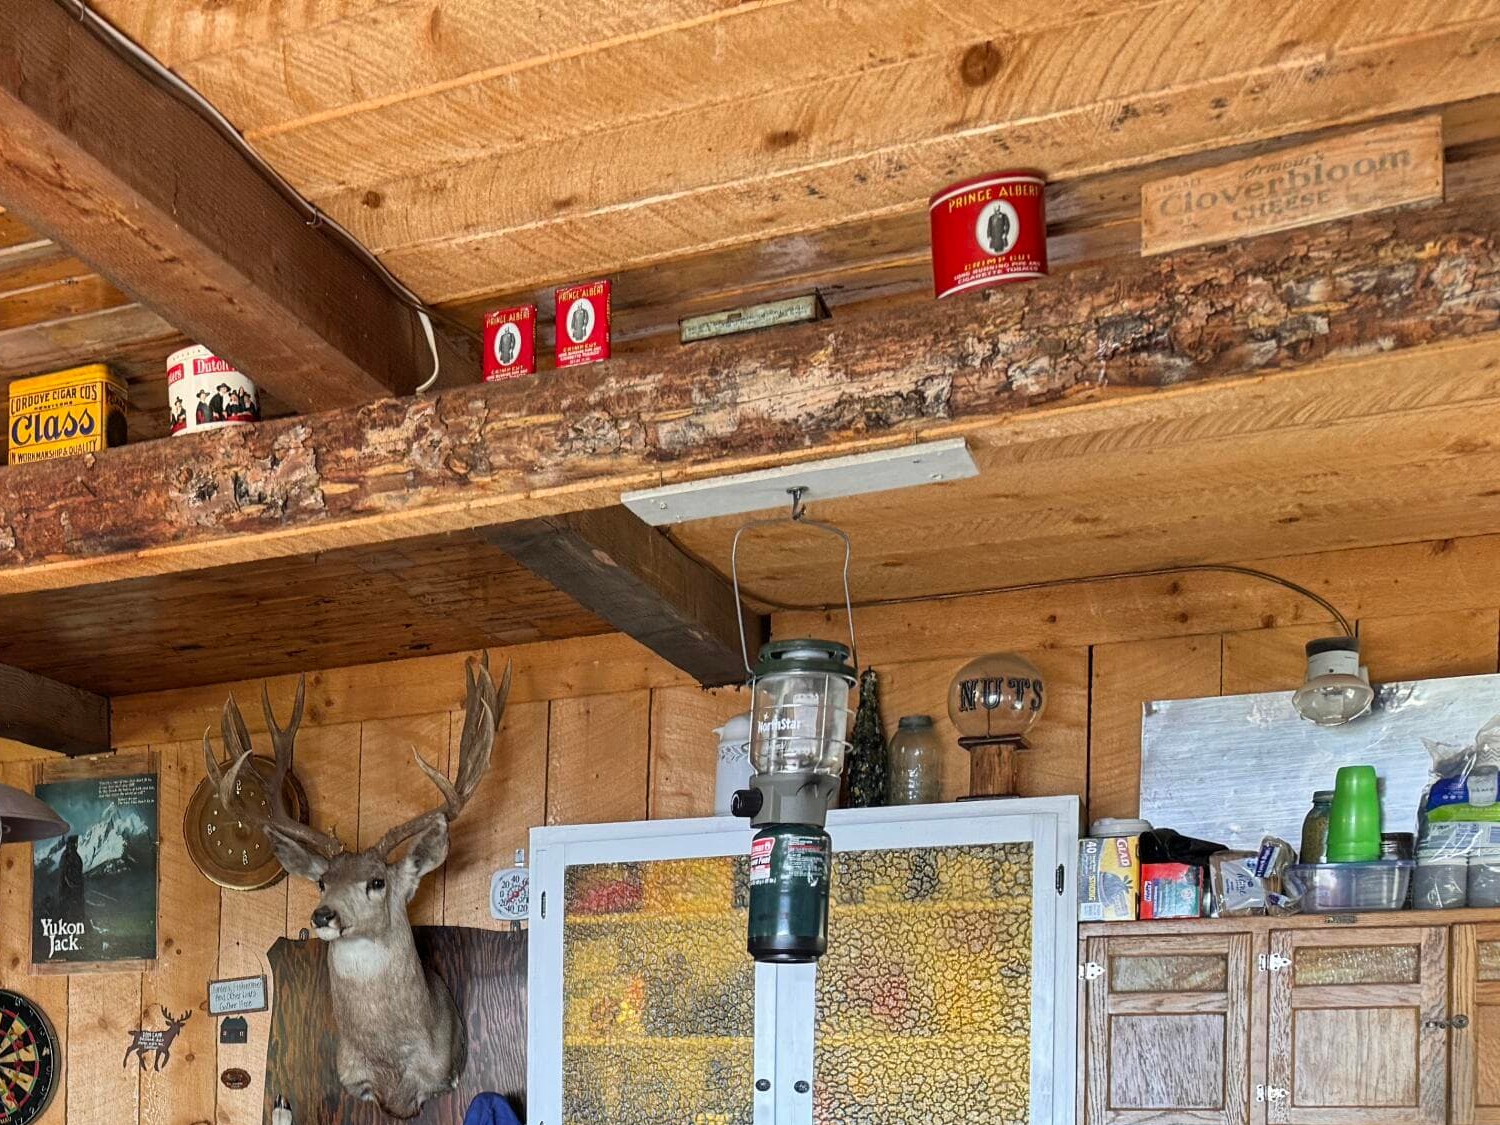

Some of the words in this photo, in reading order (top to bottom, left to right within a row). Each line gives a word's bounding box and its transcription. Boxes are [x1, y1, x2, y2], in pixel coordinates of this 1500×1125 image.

[1159, 149, 1412, 217] Cloverbloom
[948, 189, 992, 213] PRINCE
[1232, 192, 1329, 222] CHEESE
[582, 284, 604, 297] ALBERT
[509, 311, 530, 321] ALBERT
[52, 389, 77, 403] CIGAR
[11, 408, 95, 445] Class
[68, 439, 98, 456] QUALITY
[1086, 841, 1097, 854] 40
[1116, 839, 1131, 867] GLAD
[511, 875, 520, 883] 40
[41, 918, 85, 937] Yukon
[49, 936, 80, 959] Jack
